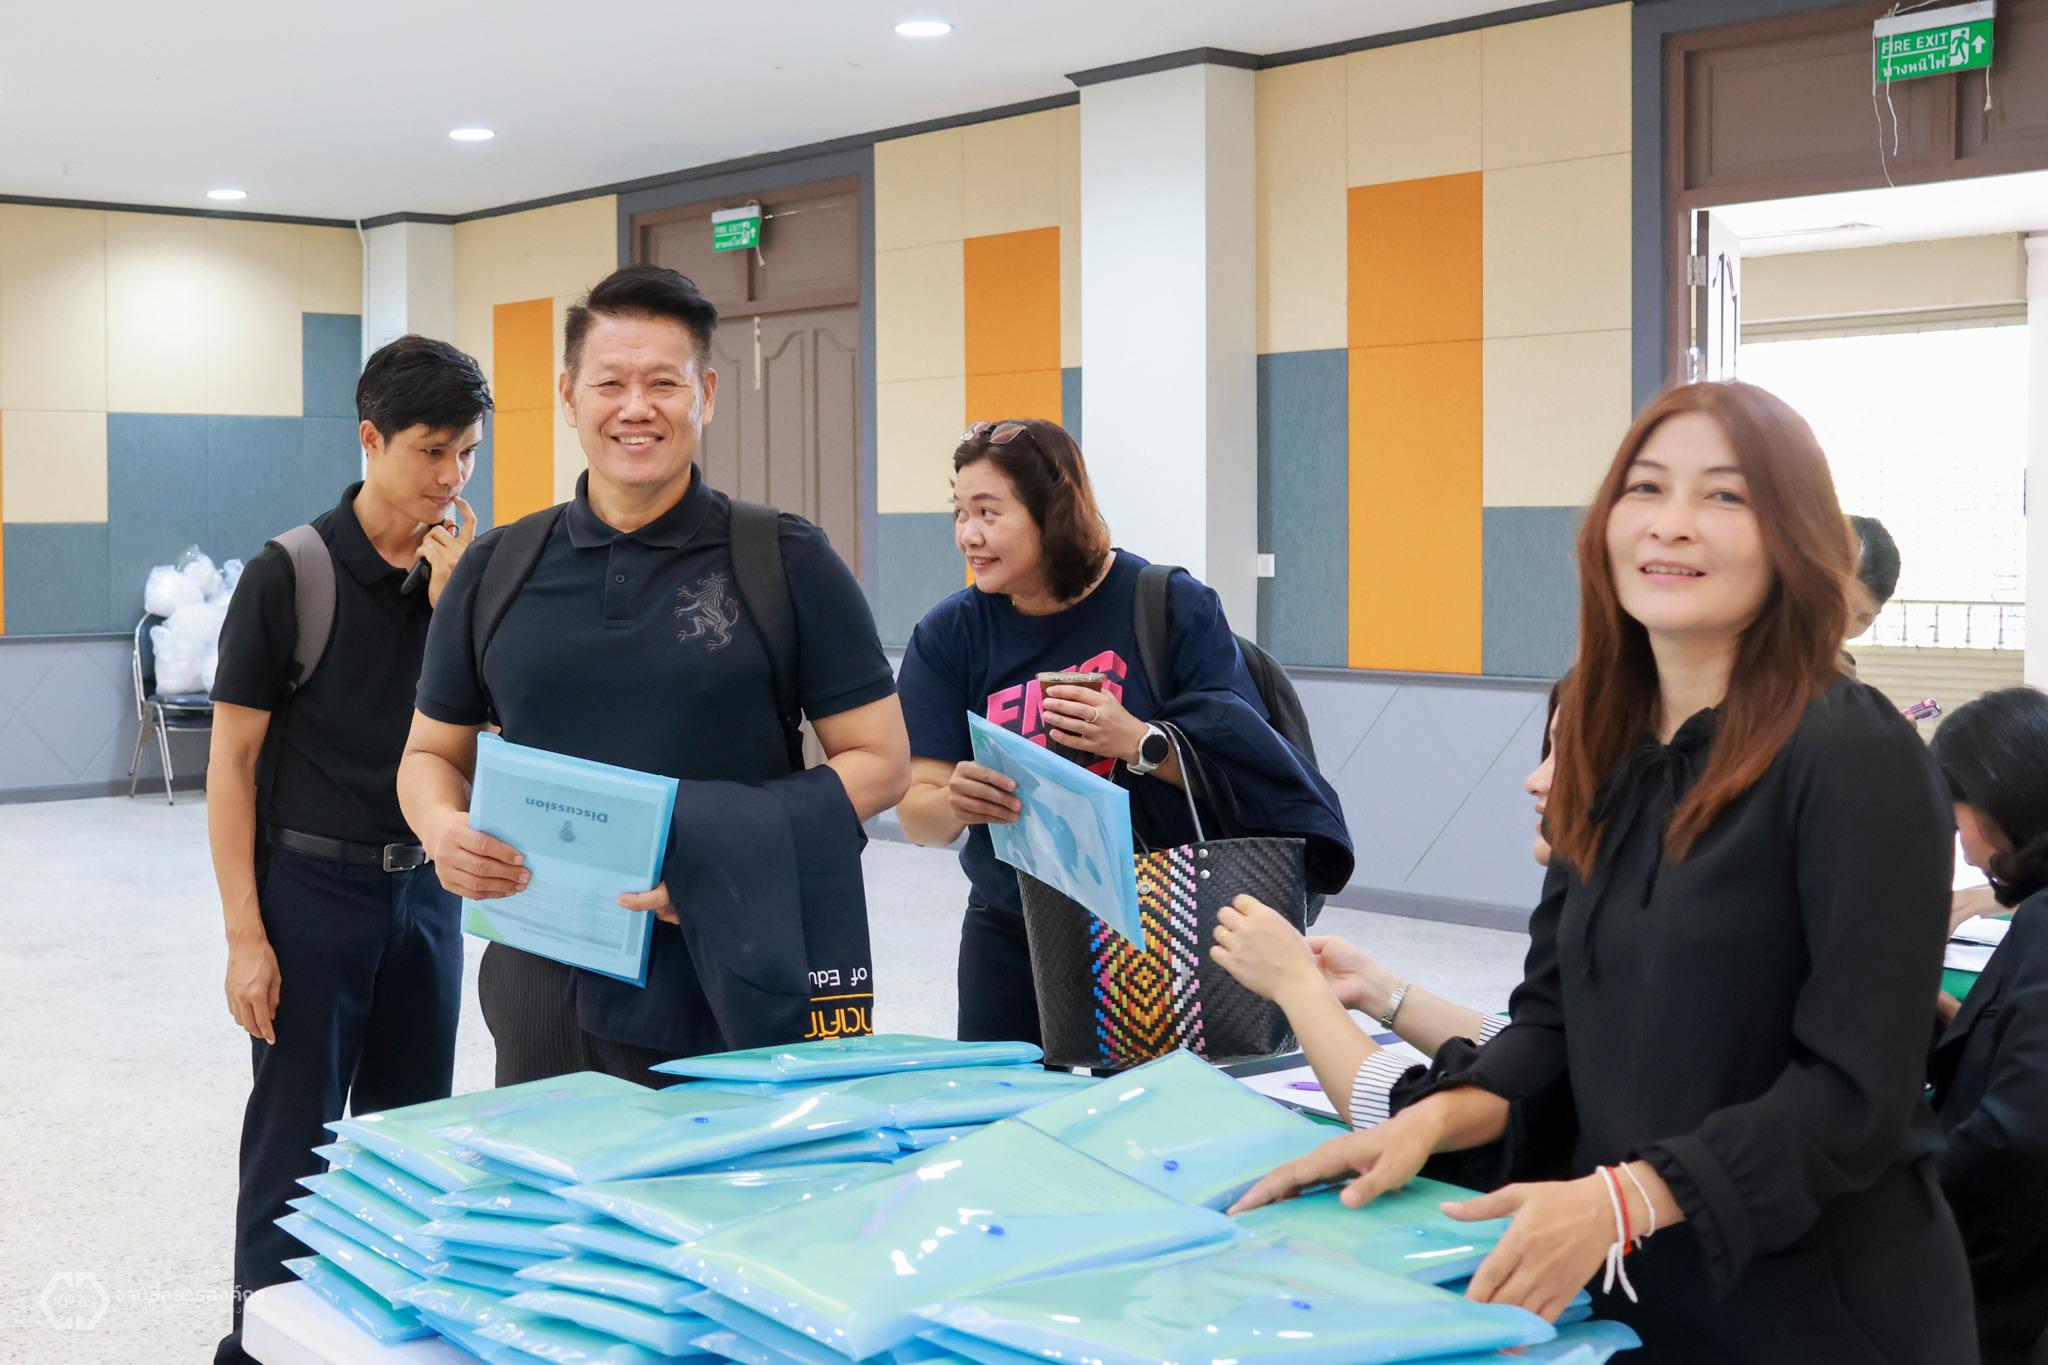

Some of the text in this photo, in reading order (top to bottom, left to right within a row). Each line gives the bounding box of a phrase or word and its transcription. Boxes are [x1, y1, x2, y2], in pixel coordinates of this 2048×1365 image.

[1882, 32, 1949, 54] FIRE EXIT
[525, 797, 608, 823] Discussion
[850, 967, 868, 986] of
